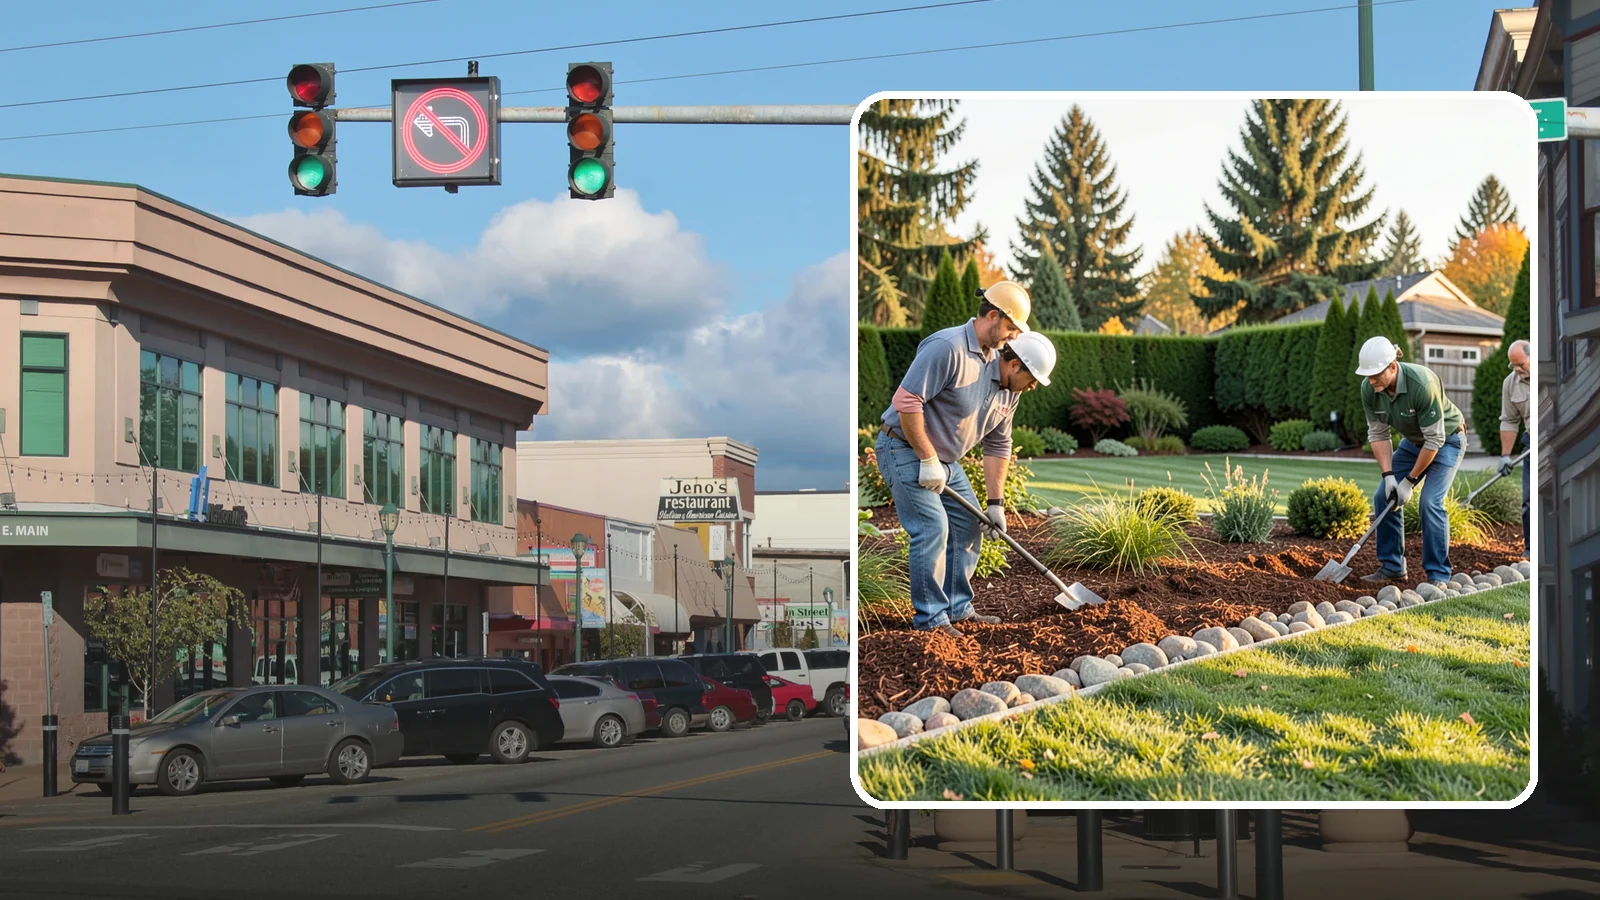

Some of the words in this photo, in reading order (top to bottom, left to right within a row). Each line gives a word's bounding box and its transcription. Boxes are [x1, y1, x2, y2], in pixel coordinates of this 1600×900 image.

[669, 480, 728, 494] Jeno's
[665, 496, 731, 509] restaurant
[686, 510, 714, 519] American
[715, 509, 738, 519] Cuisine
[2, 525, 13, 536] E.
[15, 525, 49, 536] MAIN
[797, 607, 828, 616] Street
